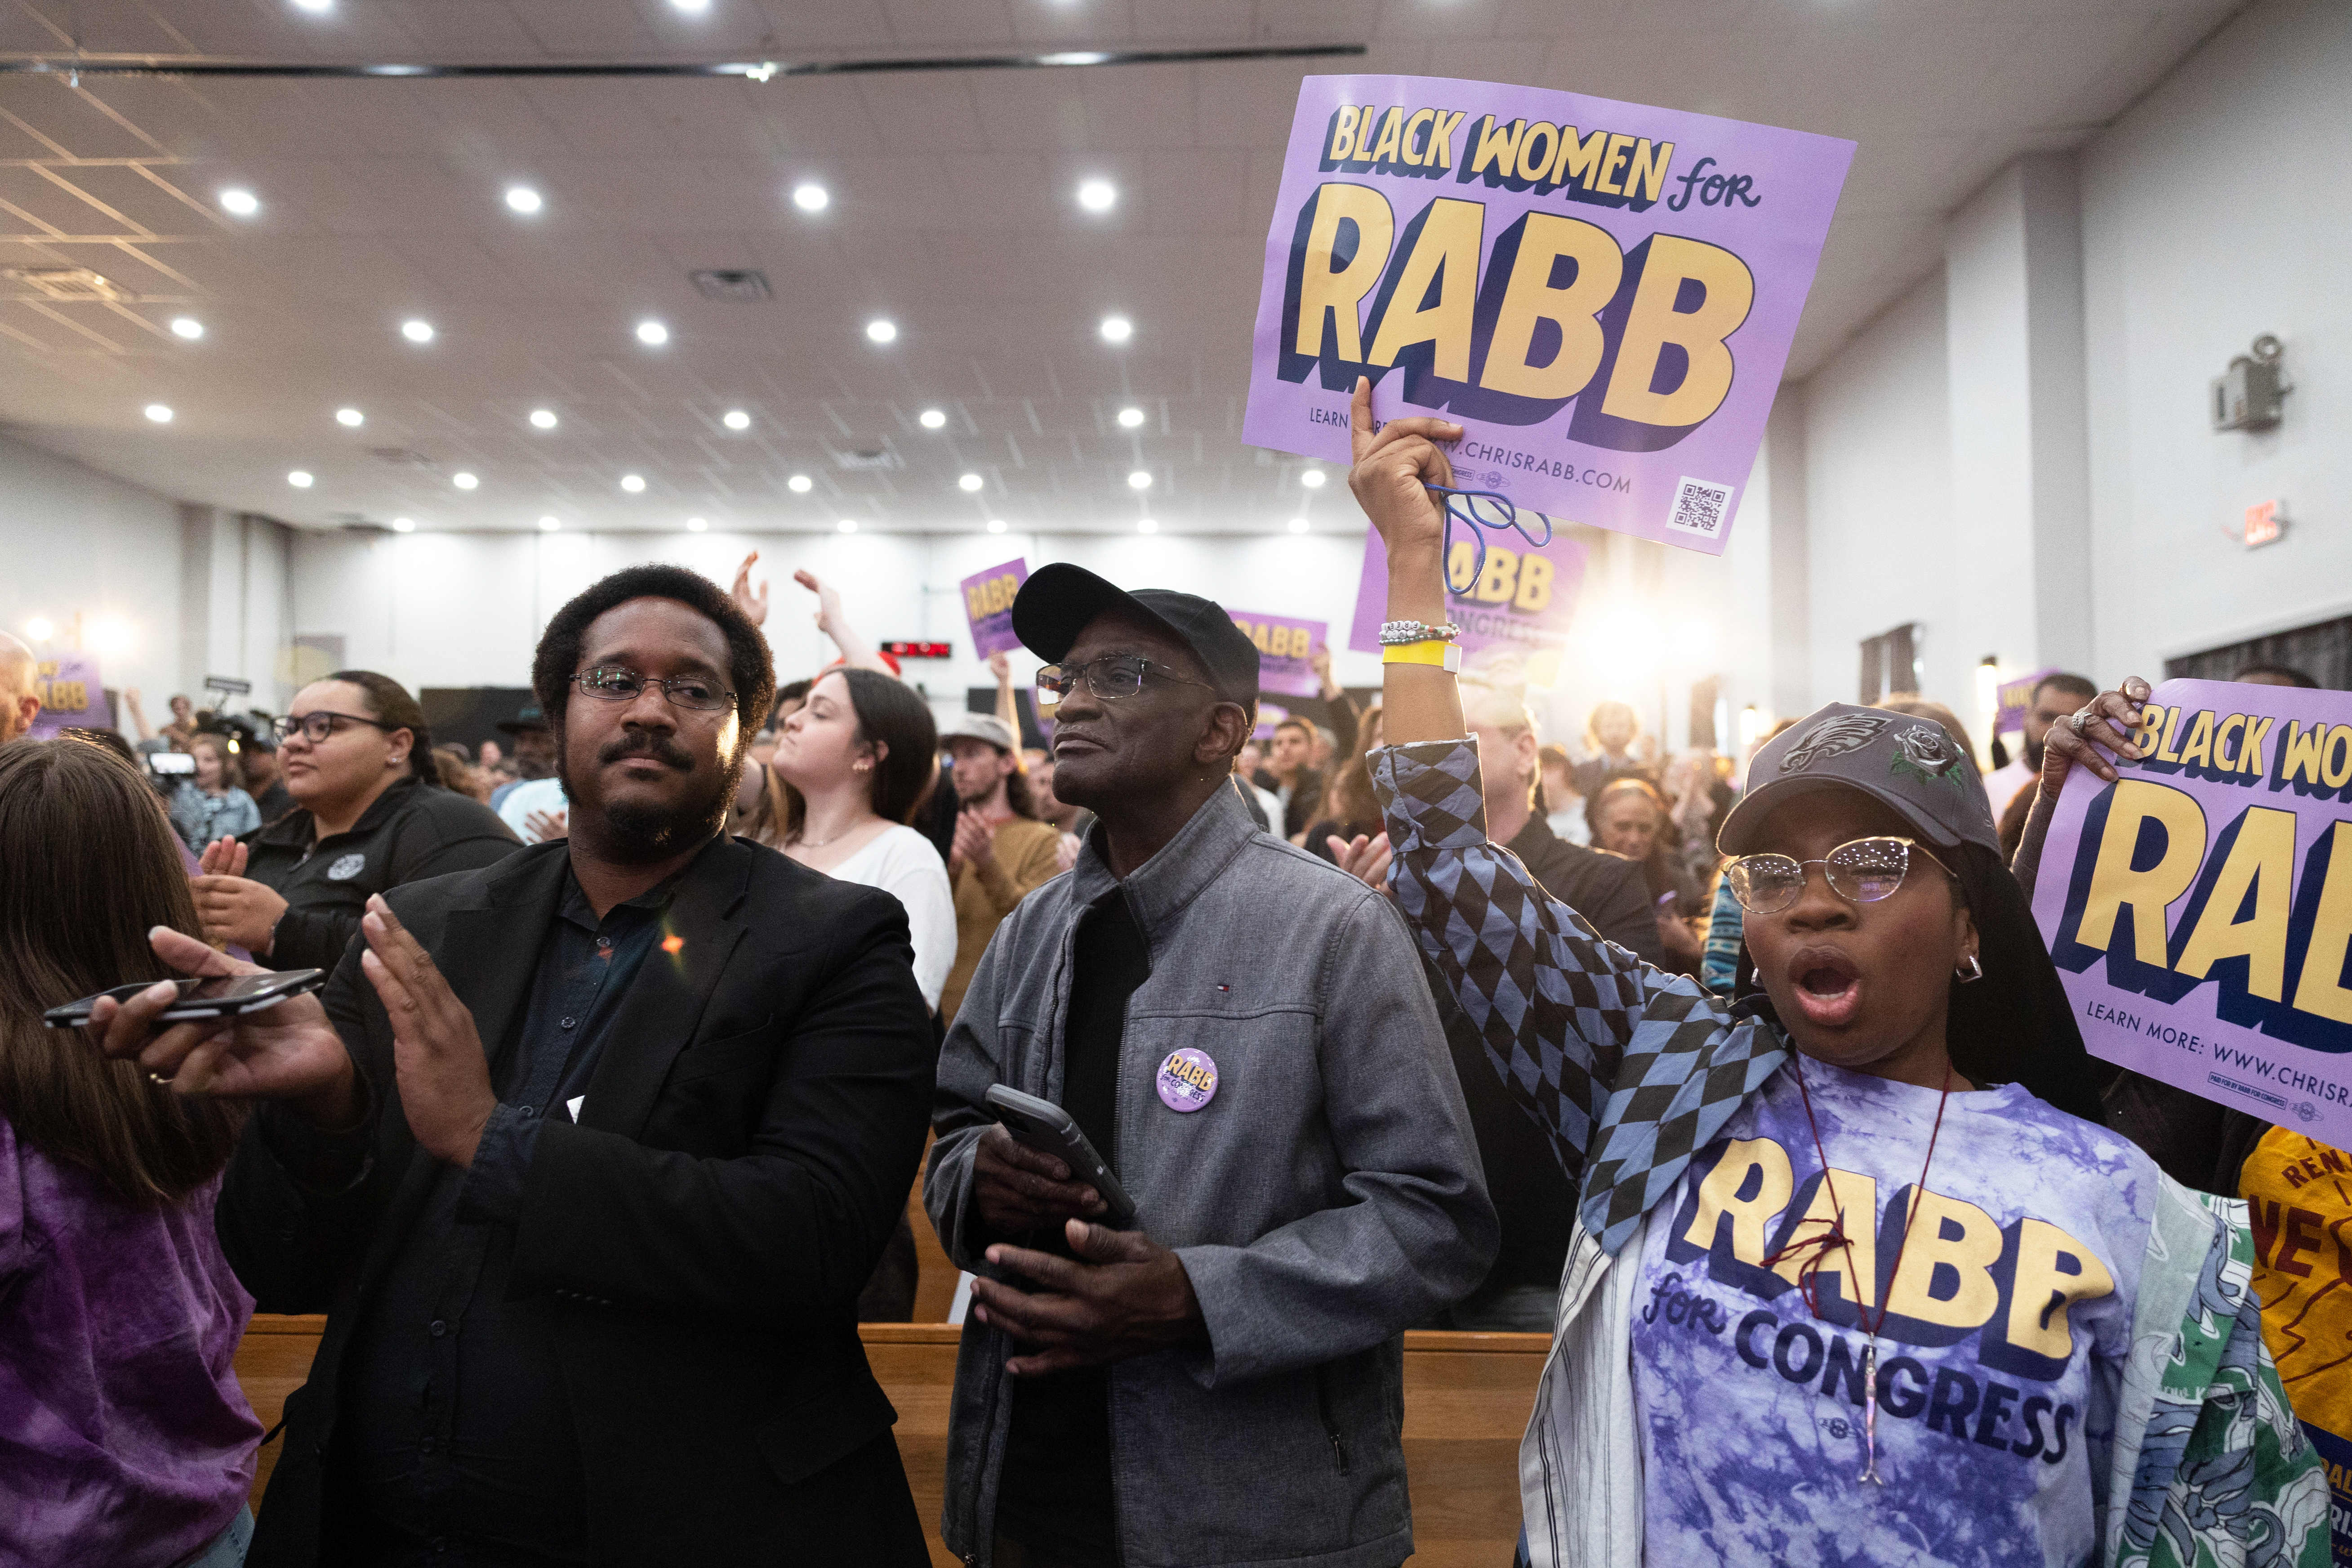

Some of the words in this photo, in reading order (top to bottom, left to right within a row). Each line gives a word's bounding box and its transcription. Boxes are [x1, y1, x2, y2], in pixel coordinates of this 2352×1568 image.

[1319, 105, 1467, 181] BLACK
[1457, 114, 1676, 213] WOMEN
[1277, 182, 1755, 452] RABB
[1309, 407, 1348, 428] LEARN
[1440, 438, 1631, 494] W.CHRISRABB.COM
[1452, 468, 1473, 478] ONGRESS
[1445, 541, 1555, 613] ABB
[2116, 703, 2276, 787] BLACK
[1166, 1055, 1215, 1092] RABB
[2087, 1001, 2141, 1033] LEARN
[2146, 1021, 2205, 1055] MORE:
[2214, 1042, 2352, 1108] WWW.CHRISR
[2281, 1149, 2352, 1189] REN
[1665, 1136, 2115, 1381] RABB
[1734, 1309, 2074, 1465] CONGRESS
